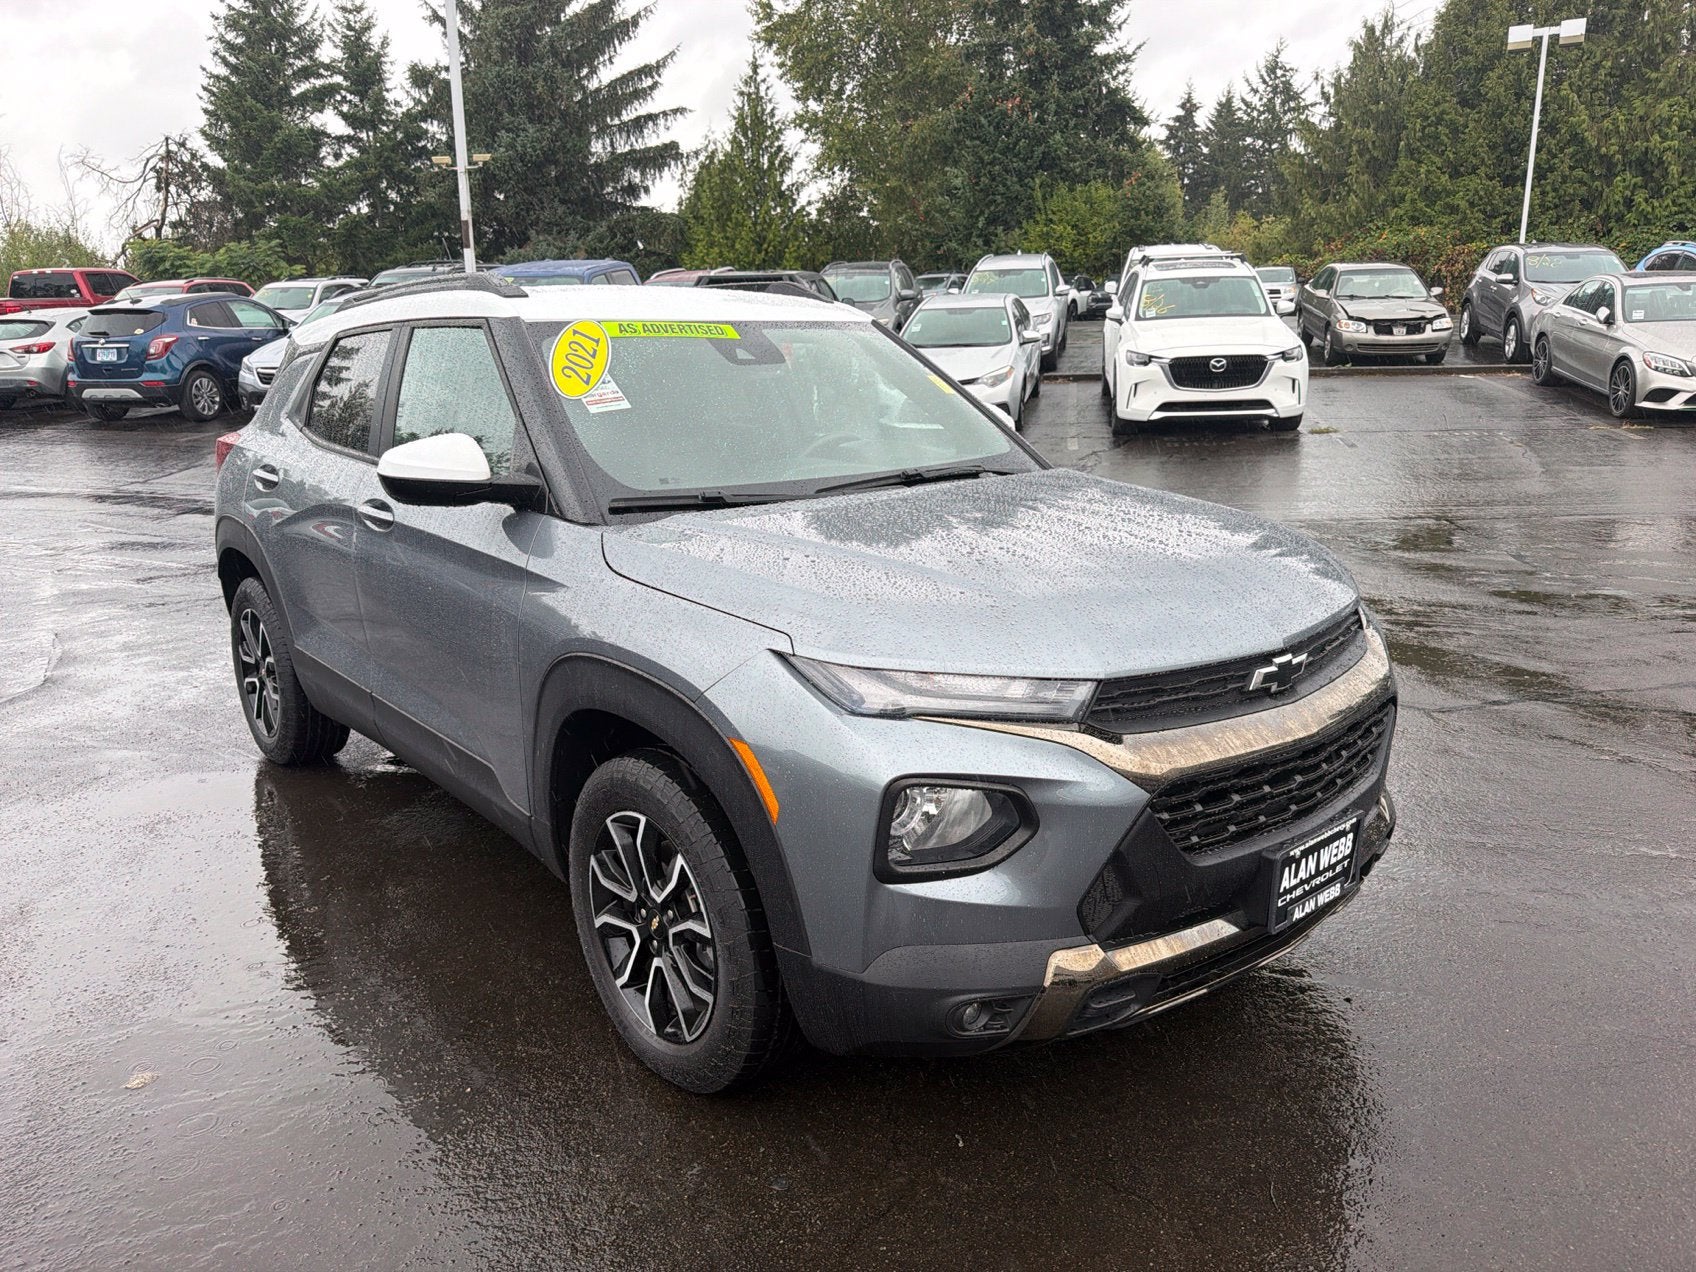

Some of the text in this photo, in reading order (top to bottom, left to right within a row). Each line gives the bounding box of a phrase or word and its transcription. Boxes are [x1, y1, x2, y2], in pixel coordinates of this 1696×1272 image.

[617, 323, 728, 337] AS ADVERTISED
[561, 328, 601, 386] 2021
[1277, 858, 1350, 907] CHEVROLET
[1280, 851, 1318, 893] ALAN
[1319, 832, 1354, 871] WEBB
[1292, 882, 1341, 922] ALAN WEBB
